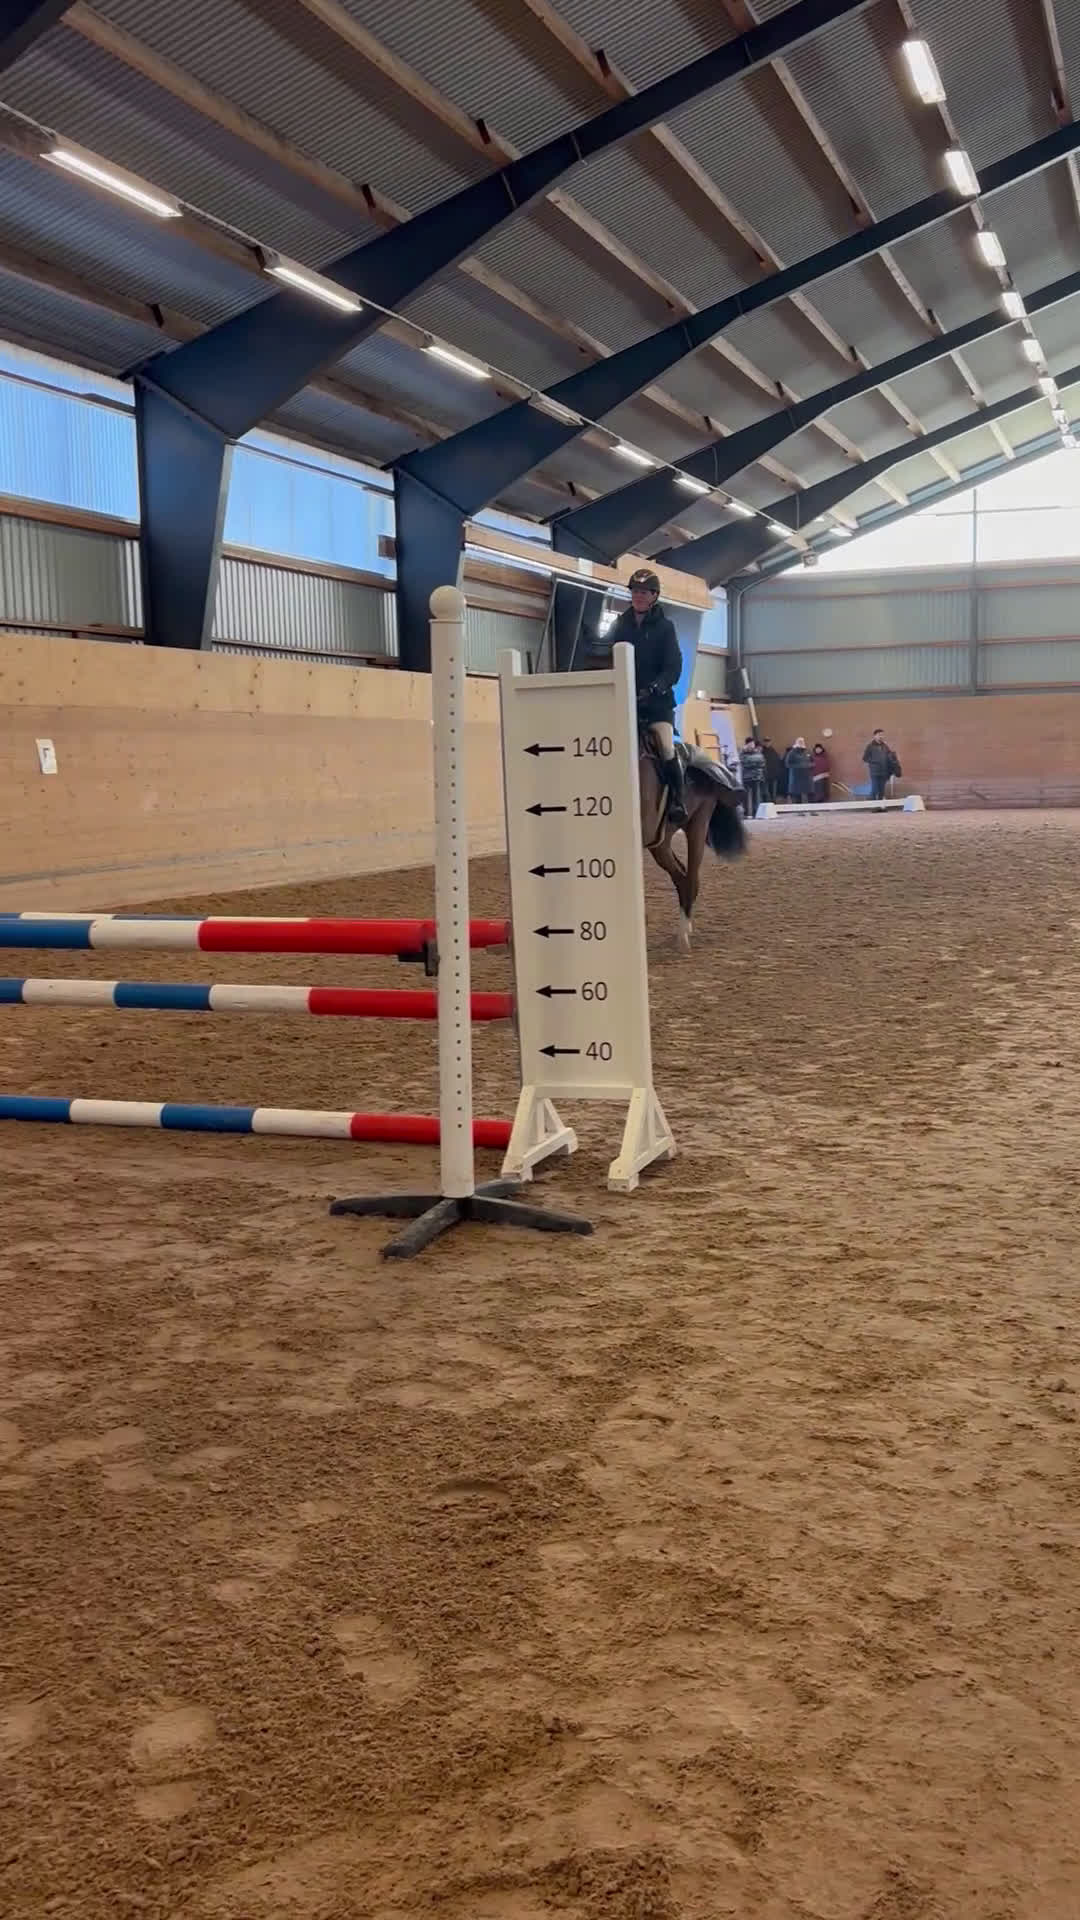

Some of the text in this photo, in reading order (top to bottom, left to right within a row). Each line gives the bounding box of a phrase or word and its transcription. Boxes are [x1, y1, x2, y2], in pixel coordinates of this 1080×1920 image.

[572, 736, 613, 757] 140
[572, 796, 613, 816] 120
[575, 858, 616, 878] 100
[580, 921, 607, 941] 80
[581, 982, 608, 1001] 60
[585, 1042, 613, 1061] 40
